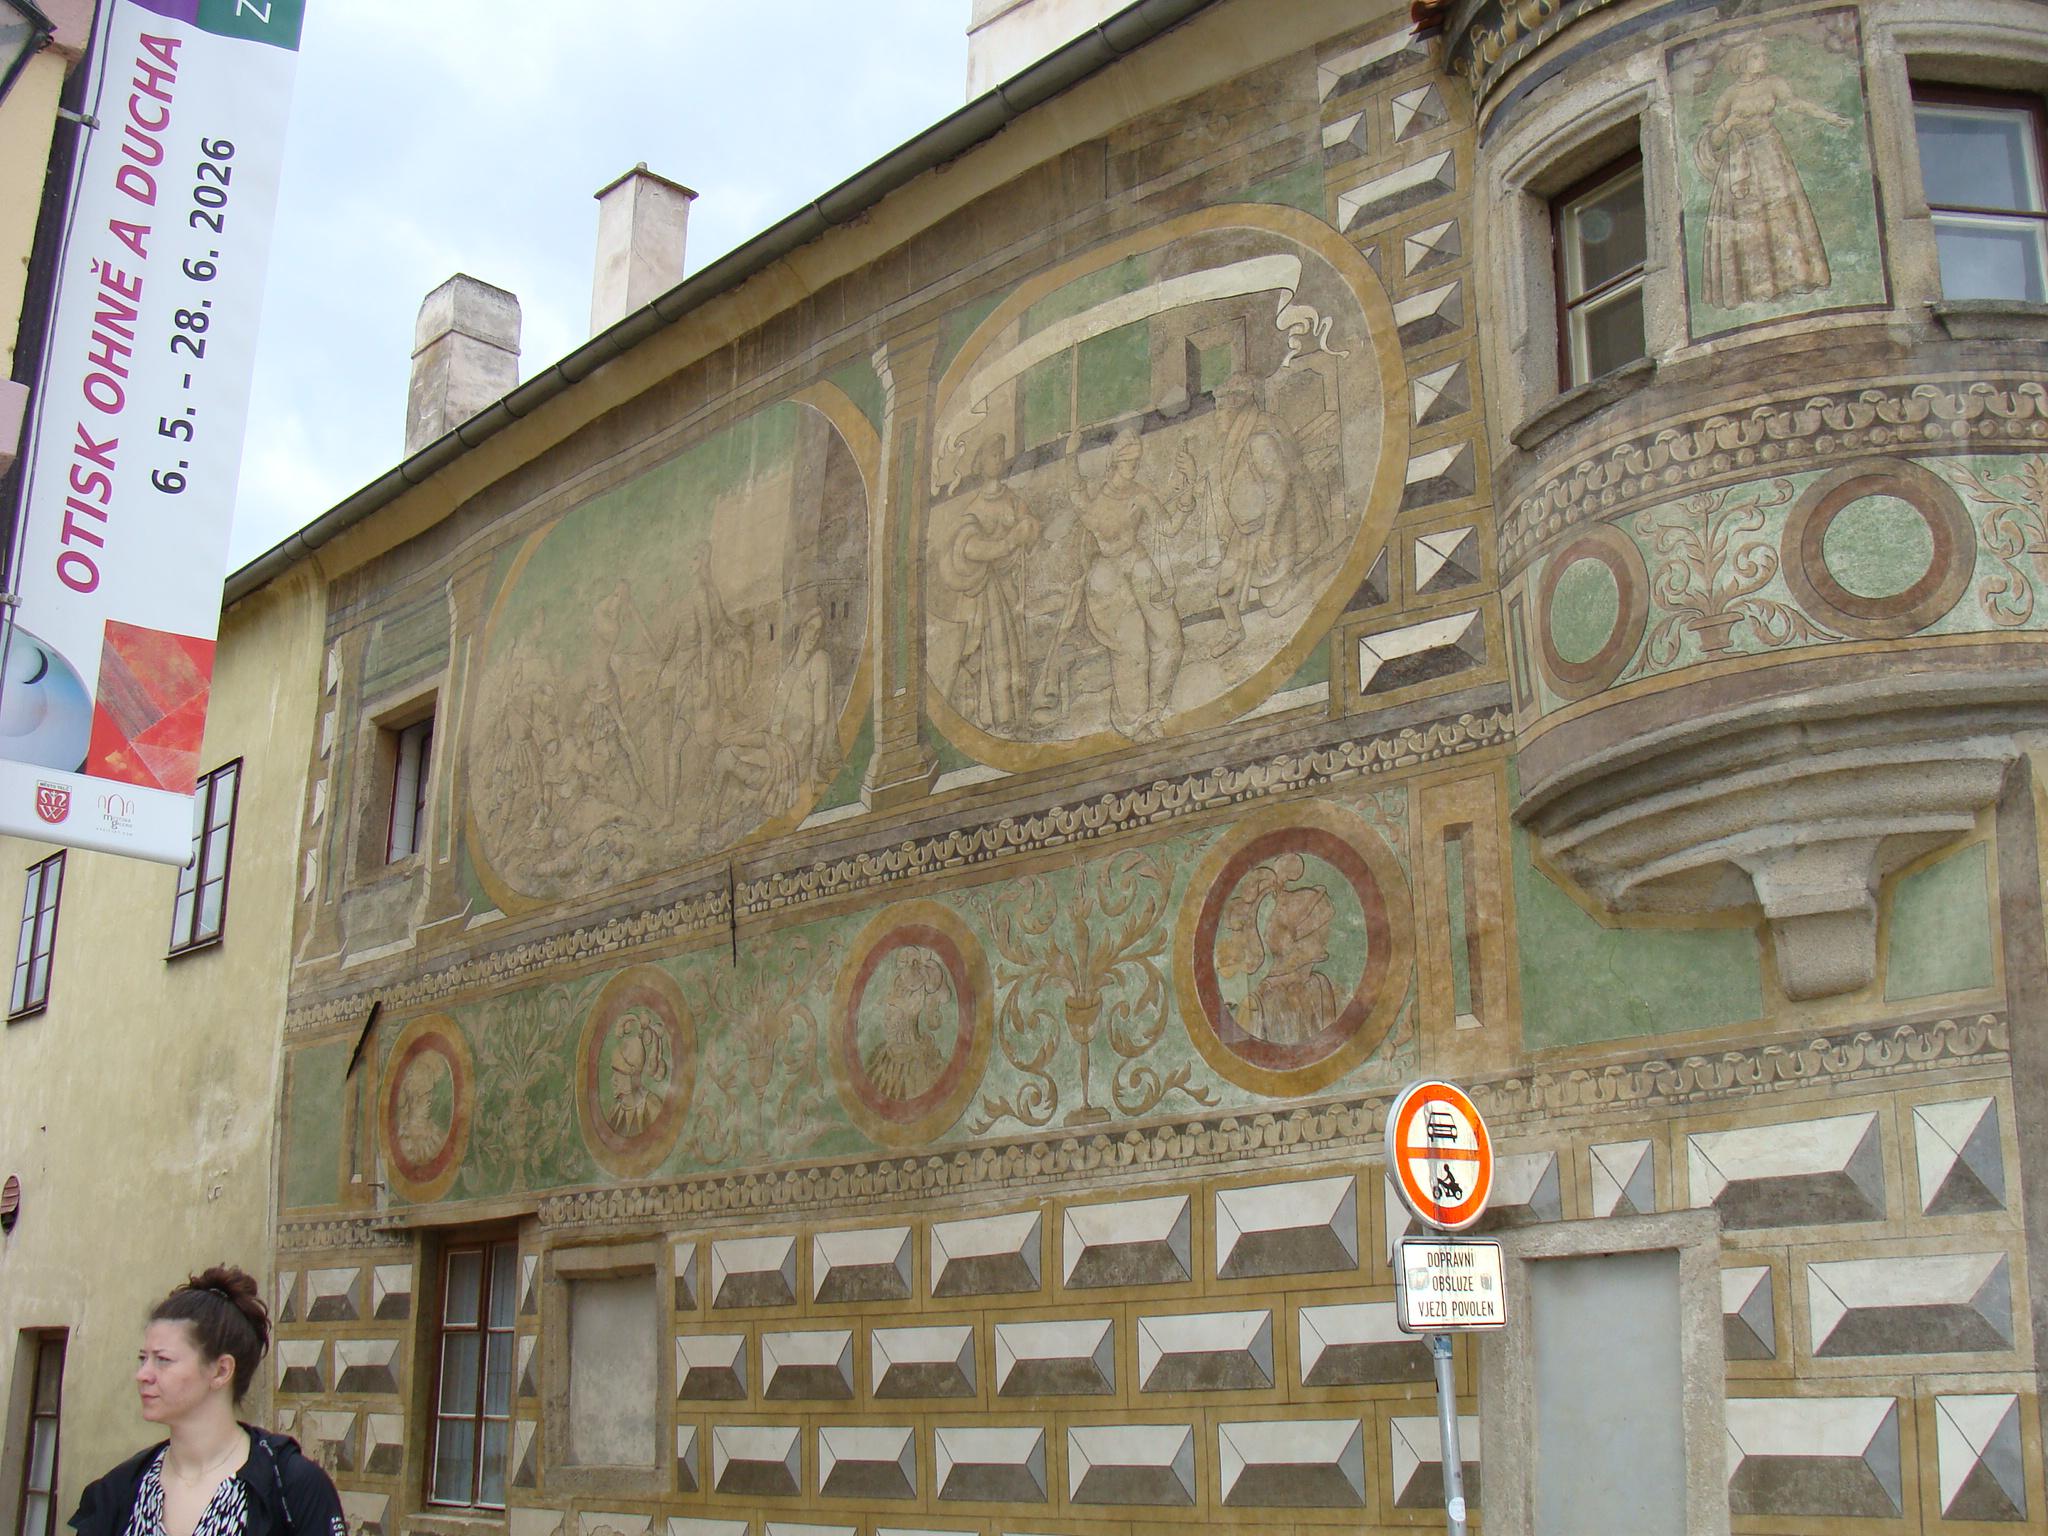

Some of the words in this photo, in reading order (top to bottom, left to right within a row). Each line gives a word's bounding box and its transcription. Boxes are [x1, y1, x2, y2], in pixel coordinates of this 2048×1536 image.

[115, 32, 182, 207] DUCHA
[189, 137, 235, 234] 2026
[108, 218, 152, 260] A
[182, 250, 219, 282] 6.
[82, 257, 143, 415] OHNĚ
[170, 300, 212, 359] 28.
[157, 407, 196, 443] 5.
[151, 460, 189, 495] 6.
[56, 422, 119, 594] OTISK
[1427, 1247, 1475, 1268] DOPRAVNÍ
[1432, 1275, 1474, 1292] OBSLUZE
[1418, 1300, 1447, 1317] VJEZD
[1451, 1300, 1494, 1317] POVOLEN
